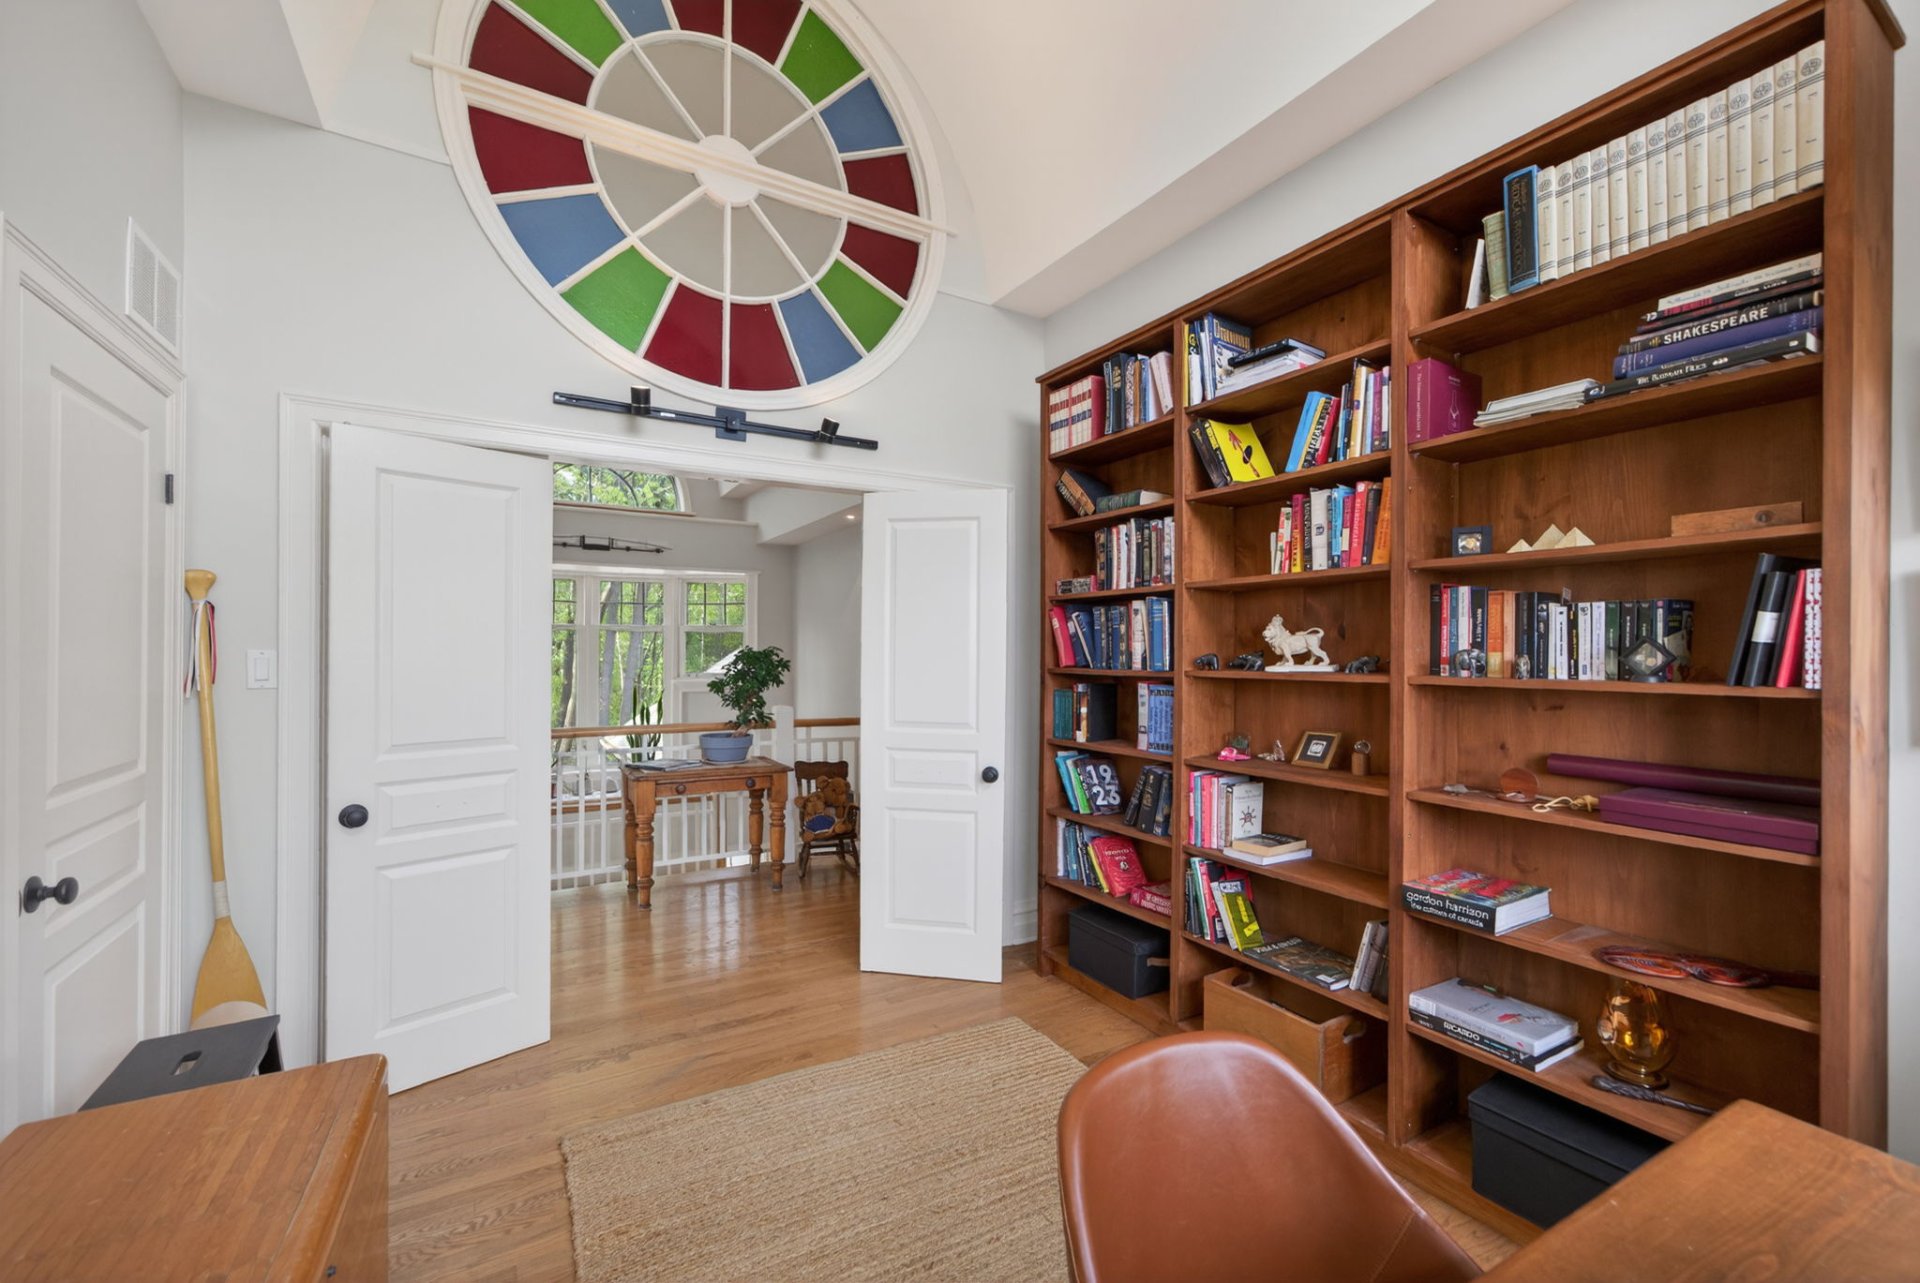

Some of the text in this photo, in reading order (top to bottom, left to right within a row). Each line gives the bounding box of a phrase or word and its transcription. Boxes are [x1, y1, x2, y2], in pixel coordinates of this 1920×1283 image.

[1663, 306, 1769, 345] SHAKESPEARE
[1086, 764, 1112, 785] 19
[1091, 784, 1121, 806] 23
[1406, 891, 1489, 920] gordon harrison
[1448, 912, 1457, 920] of
